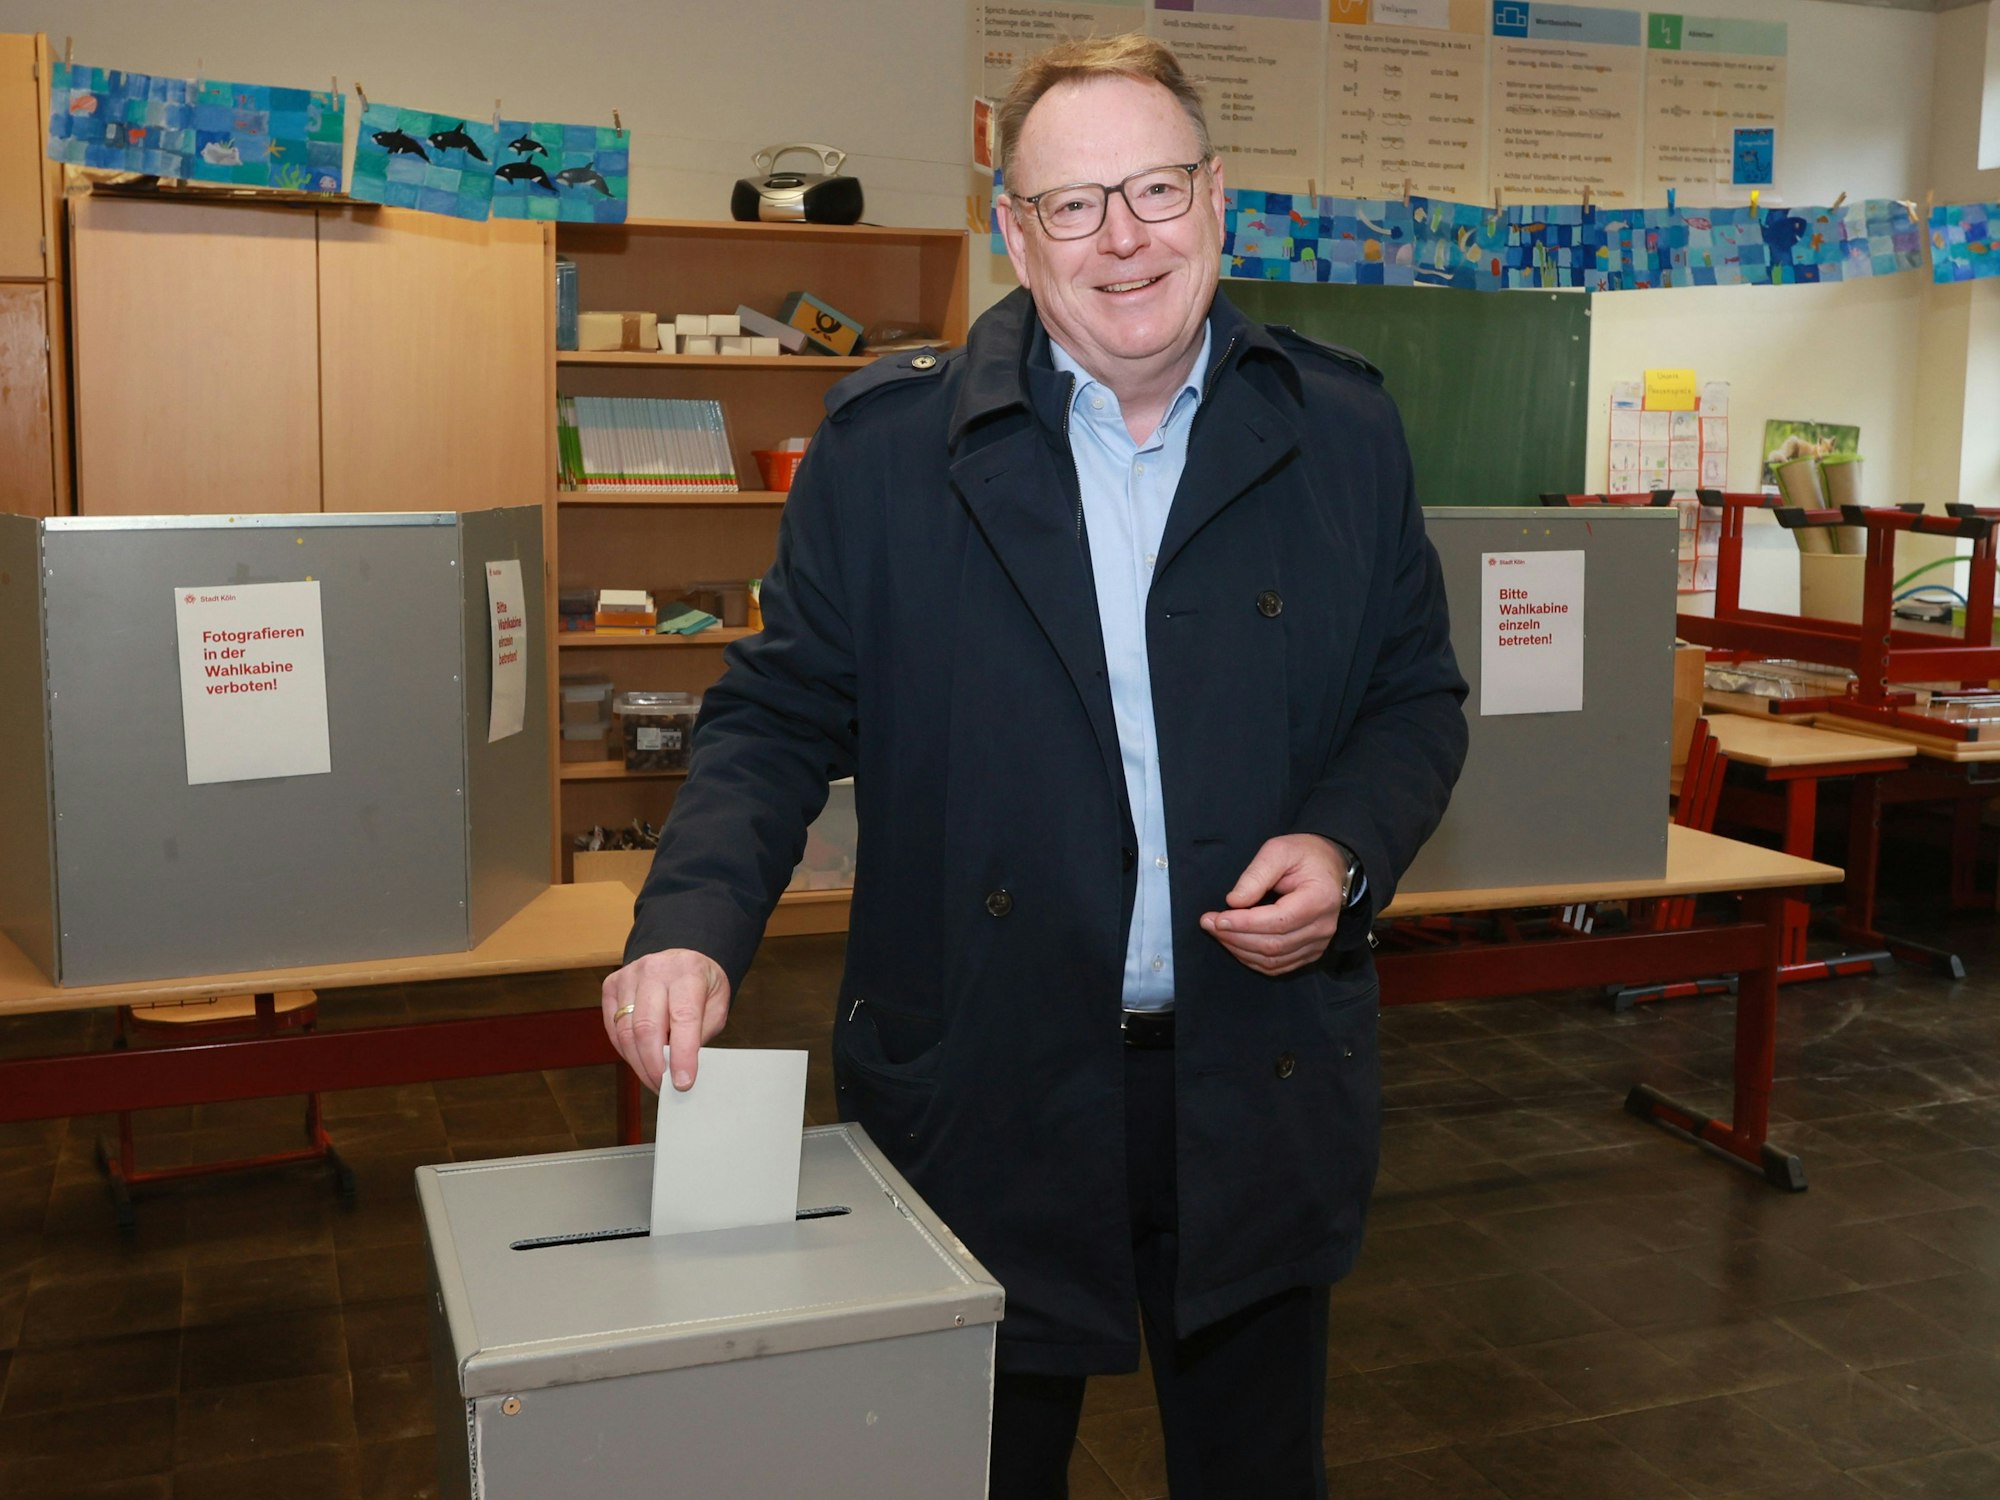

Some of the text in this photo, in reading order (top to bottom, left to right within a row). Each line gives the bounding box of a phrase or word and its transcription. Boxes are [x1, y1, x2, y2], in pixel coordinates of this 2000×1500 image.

[220, 594, 236, 602] Köln
[1499, 588, 1528, 600] Bitte
[1499, 603, 1568, 616] Wahlkabine
[1498, 619, 1540, 631] einzeln
[202, 626, 305, 645] Fotografieren
[1498, 633, 1552, 647] betreten!
[203, 646, 246, 661] in der
[204, 660, 294, 679] Wahlkabine
[206, 678, 279, 696] verboten!
